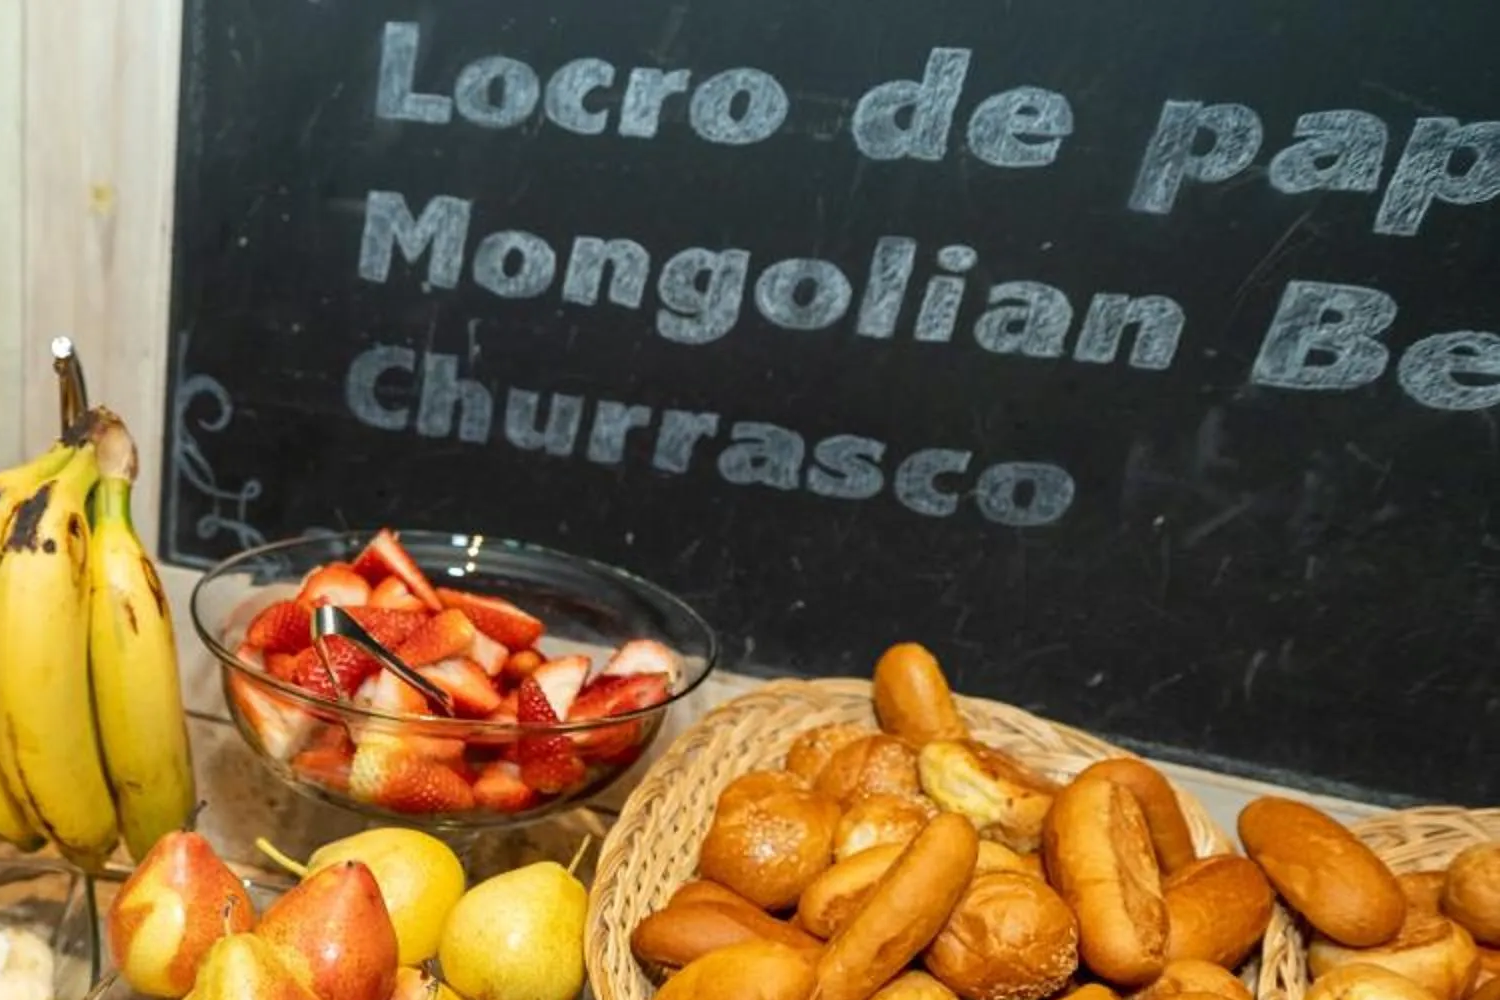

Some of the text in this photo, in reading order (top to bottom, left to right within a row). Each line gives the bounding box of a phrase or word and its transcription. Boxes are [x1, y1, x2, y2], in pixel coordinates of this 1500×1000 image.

[376, 20, 789, 145] Locro
[851, 46, 1075, 168] de
[356, 190, 1186, 370] Mongolian
[344, 346, 1076, 526] Churrasco
